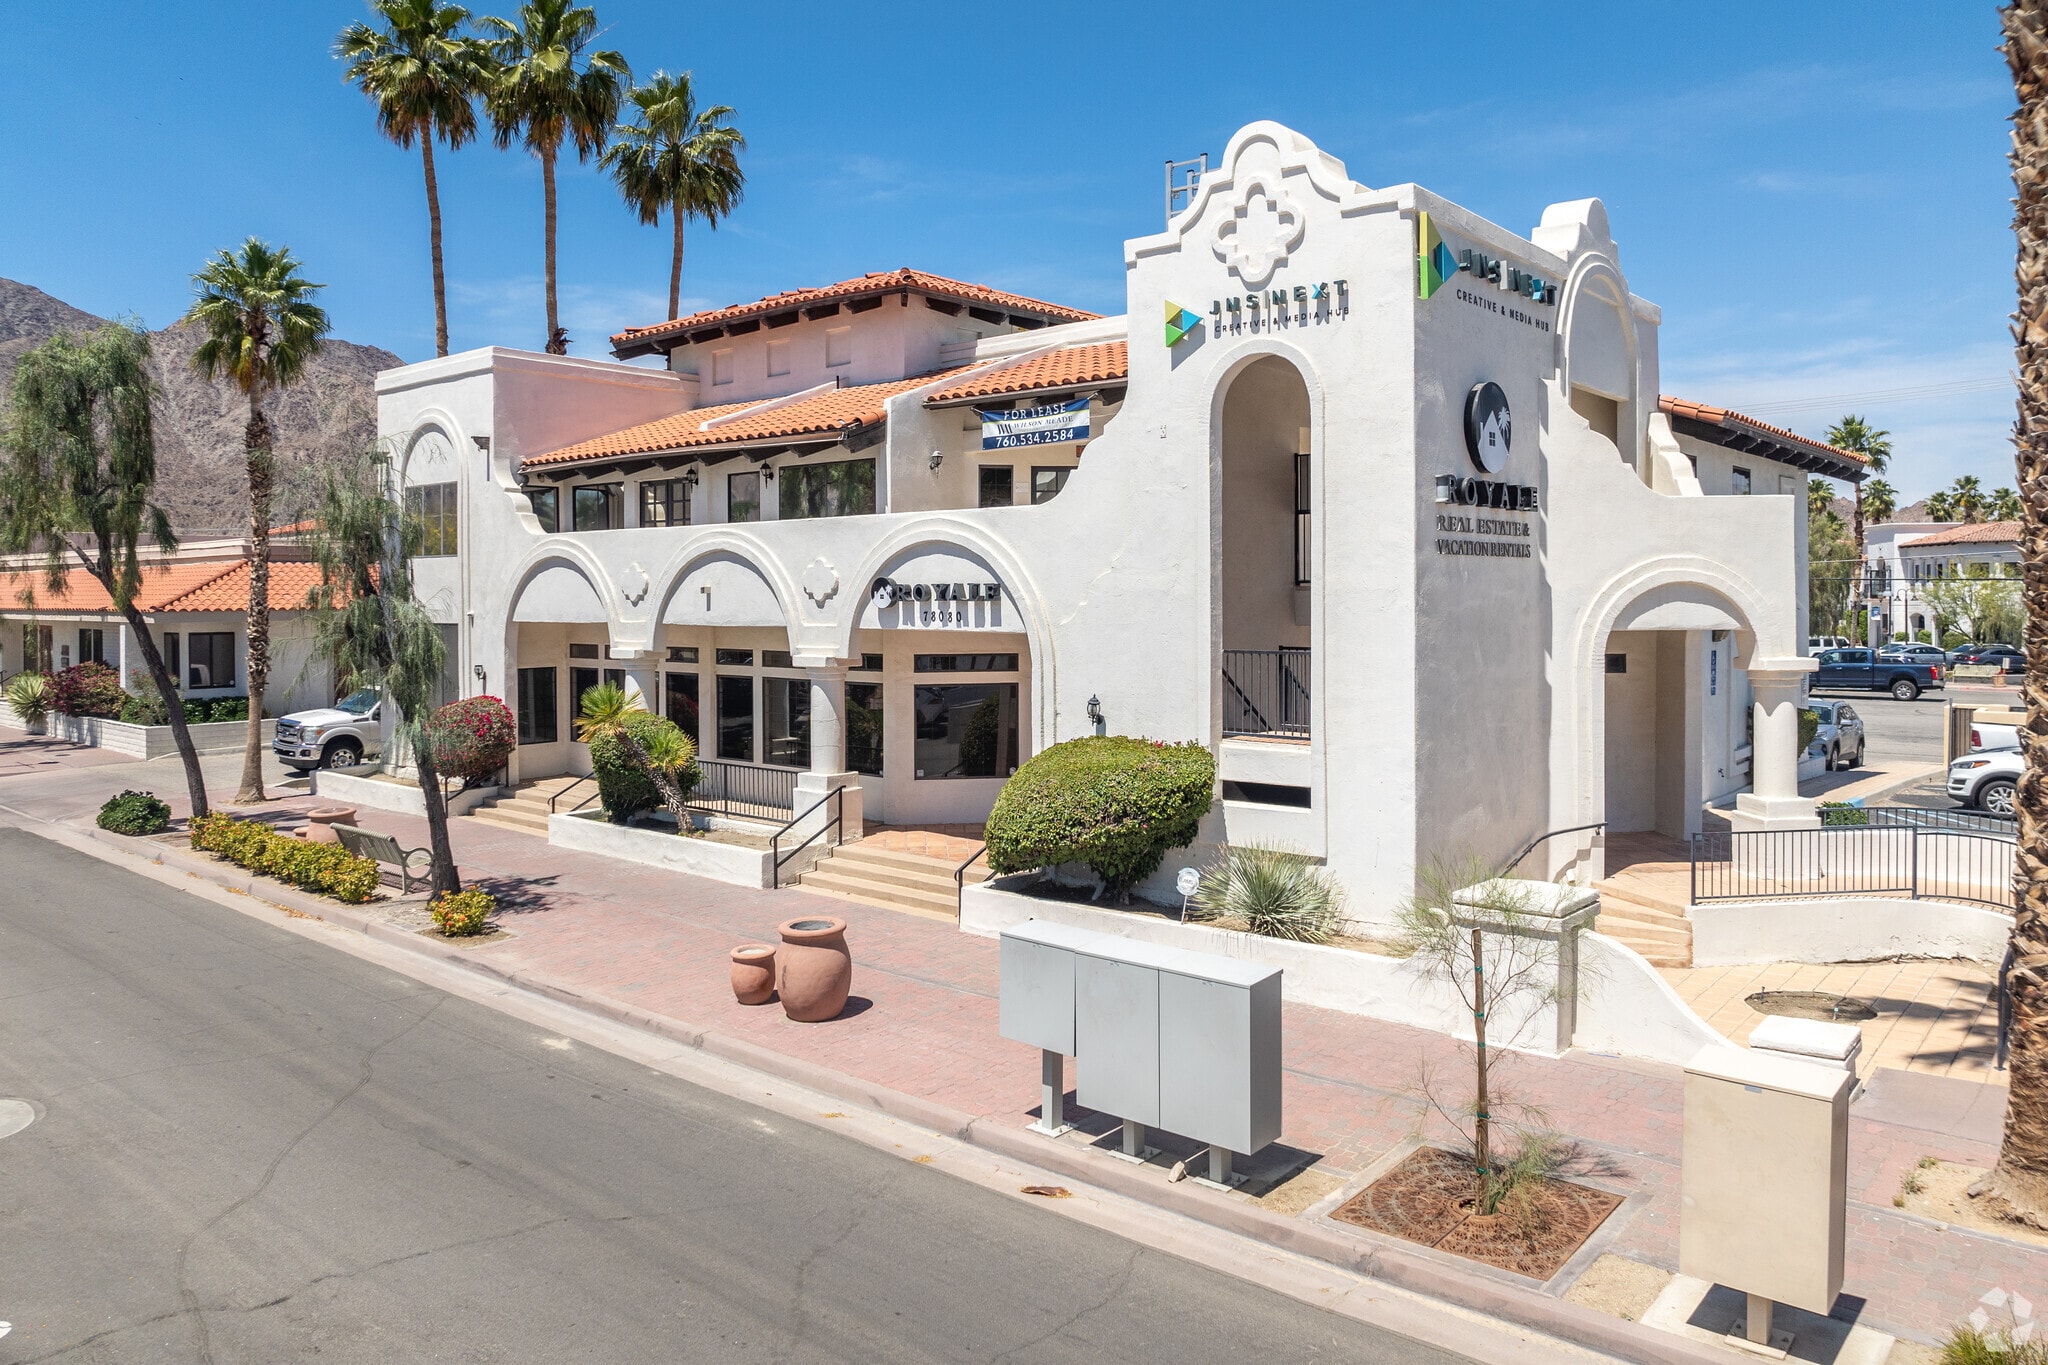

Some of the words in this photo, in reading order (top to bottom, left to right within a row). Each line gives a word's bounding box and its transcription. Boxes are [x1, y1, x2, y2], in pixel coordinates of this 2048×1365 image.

[1214, 319, 1266, 333] CREATIVE
[1273, 317, 1279, 325] &
[1285, 311, 1320, 323] MEDIA
[1327, 307, 1349, 317] HUB
[1456, 289, 1497, 312] CREATIVE
[1501, 306, 1506, 316] &
[1509, 309, 1532, 326] MEDIA
[1535, 318, 1549, 332] HUB
[1004, 410, 1027, 420] FOR
[1031, 403, 1066, 418] LEASE
[1013, 420, 1043, 429] WILSON
[1045, 415, 1074, 425] MEADE
[996, 429, 1074, 448] 760.534.2584
[1435, 474, 1538, 512] ROYALE
[1436, 514, 1474, 533] REAL
[1477, 518, 1521, 536] ESTATE
[1435, 539, 1489, 556] VACATION
[1490, 542, 1531, 558] RENTALS
[895, 583, 1001, 602] ROYALE
[923, 611, 962, 623] 78080
